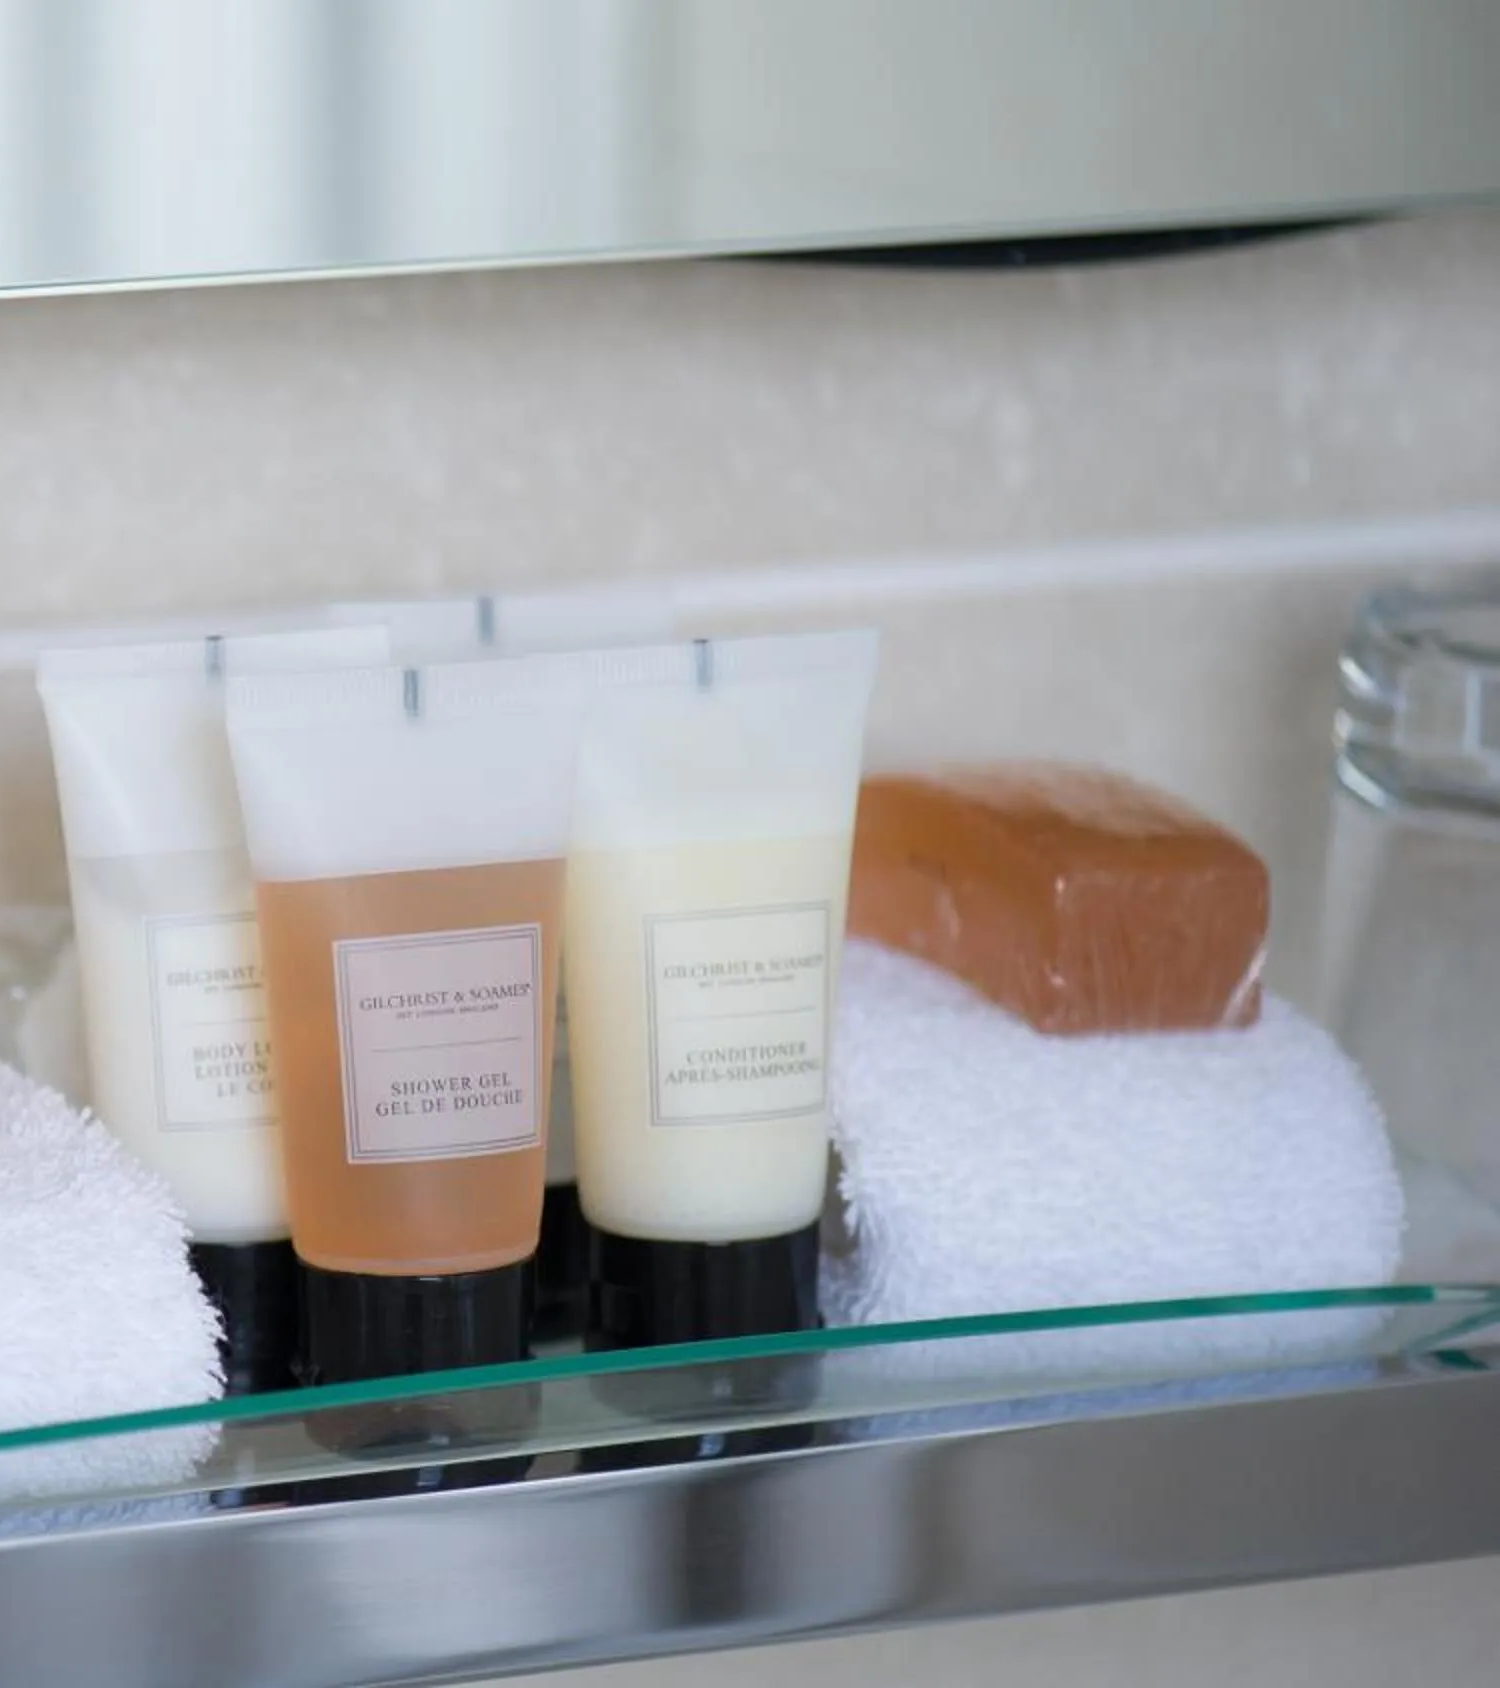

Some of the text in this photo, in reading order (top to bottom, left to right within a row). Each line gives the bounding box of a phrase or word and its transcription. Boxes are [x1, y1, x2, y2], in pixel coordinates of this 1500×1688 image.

[359, 991, 449, 1011] GILCHRIST
[453, 991, 465, 1002] &
[192, 1041, 247, 1062] BODY
[685, 1040, 807, 1065] CONDITIONER
[193, 1061, 268, 1081] LOTION
[390, 1071, 513, 1097] SHOWER GEL
[375, 1088, 524, 1117] GEL DE DOUCHE
